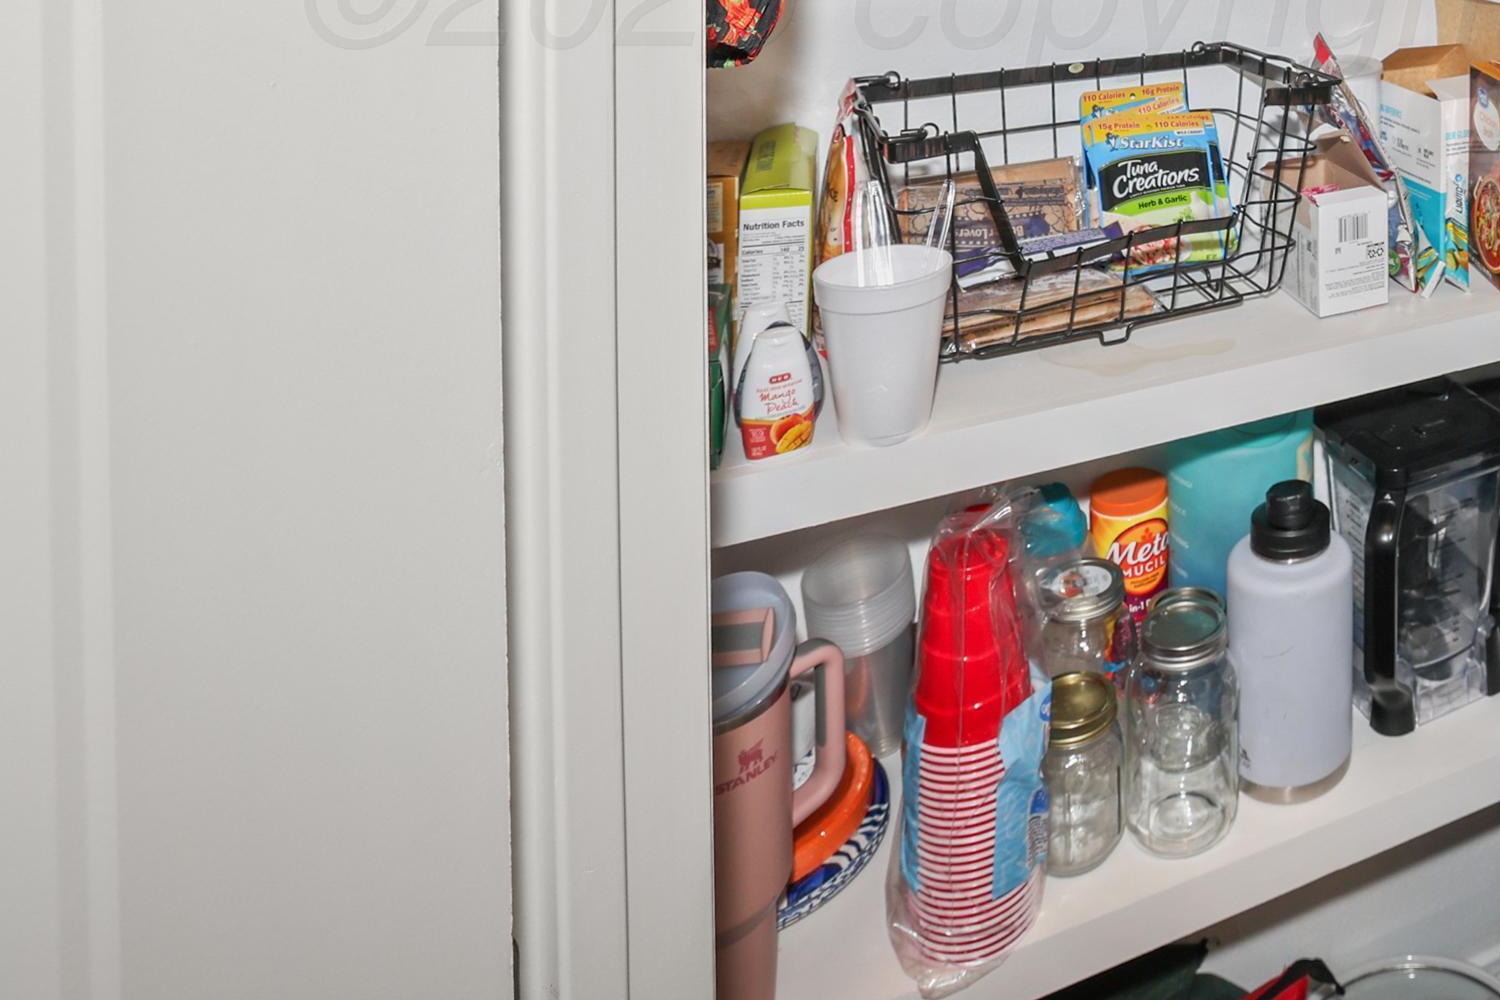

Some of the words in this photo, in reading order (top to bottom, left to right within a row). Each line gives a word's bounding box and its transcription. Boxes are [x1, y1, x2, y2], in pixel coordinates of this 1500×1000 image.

[1098, 92, 1126, 101] Calories
[1170, 120, 1199, 128] Calories
[1119, 135, 1184, 149] StarKist
[1118, 159, 1159, 178] Tuna
[1112, 167, 1200, 198] Creations
[1138, 200, 1157, 209] Herb
[1164, 194, 1188, 204] Garlic
[743, 222, 780, 231] Nutrition
[782, 219, 805, 228] Facts
[759, 388, 796, 402] Mango
